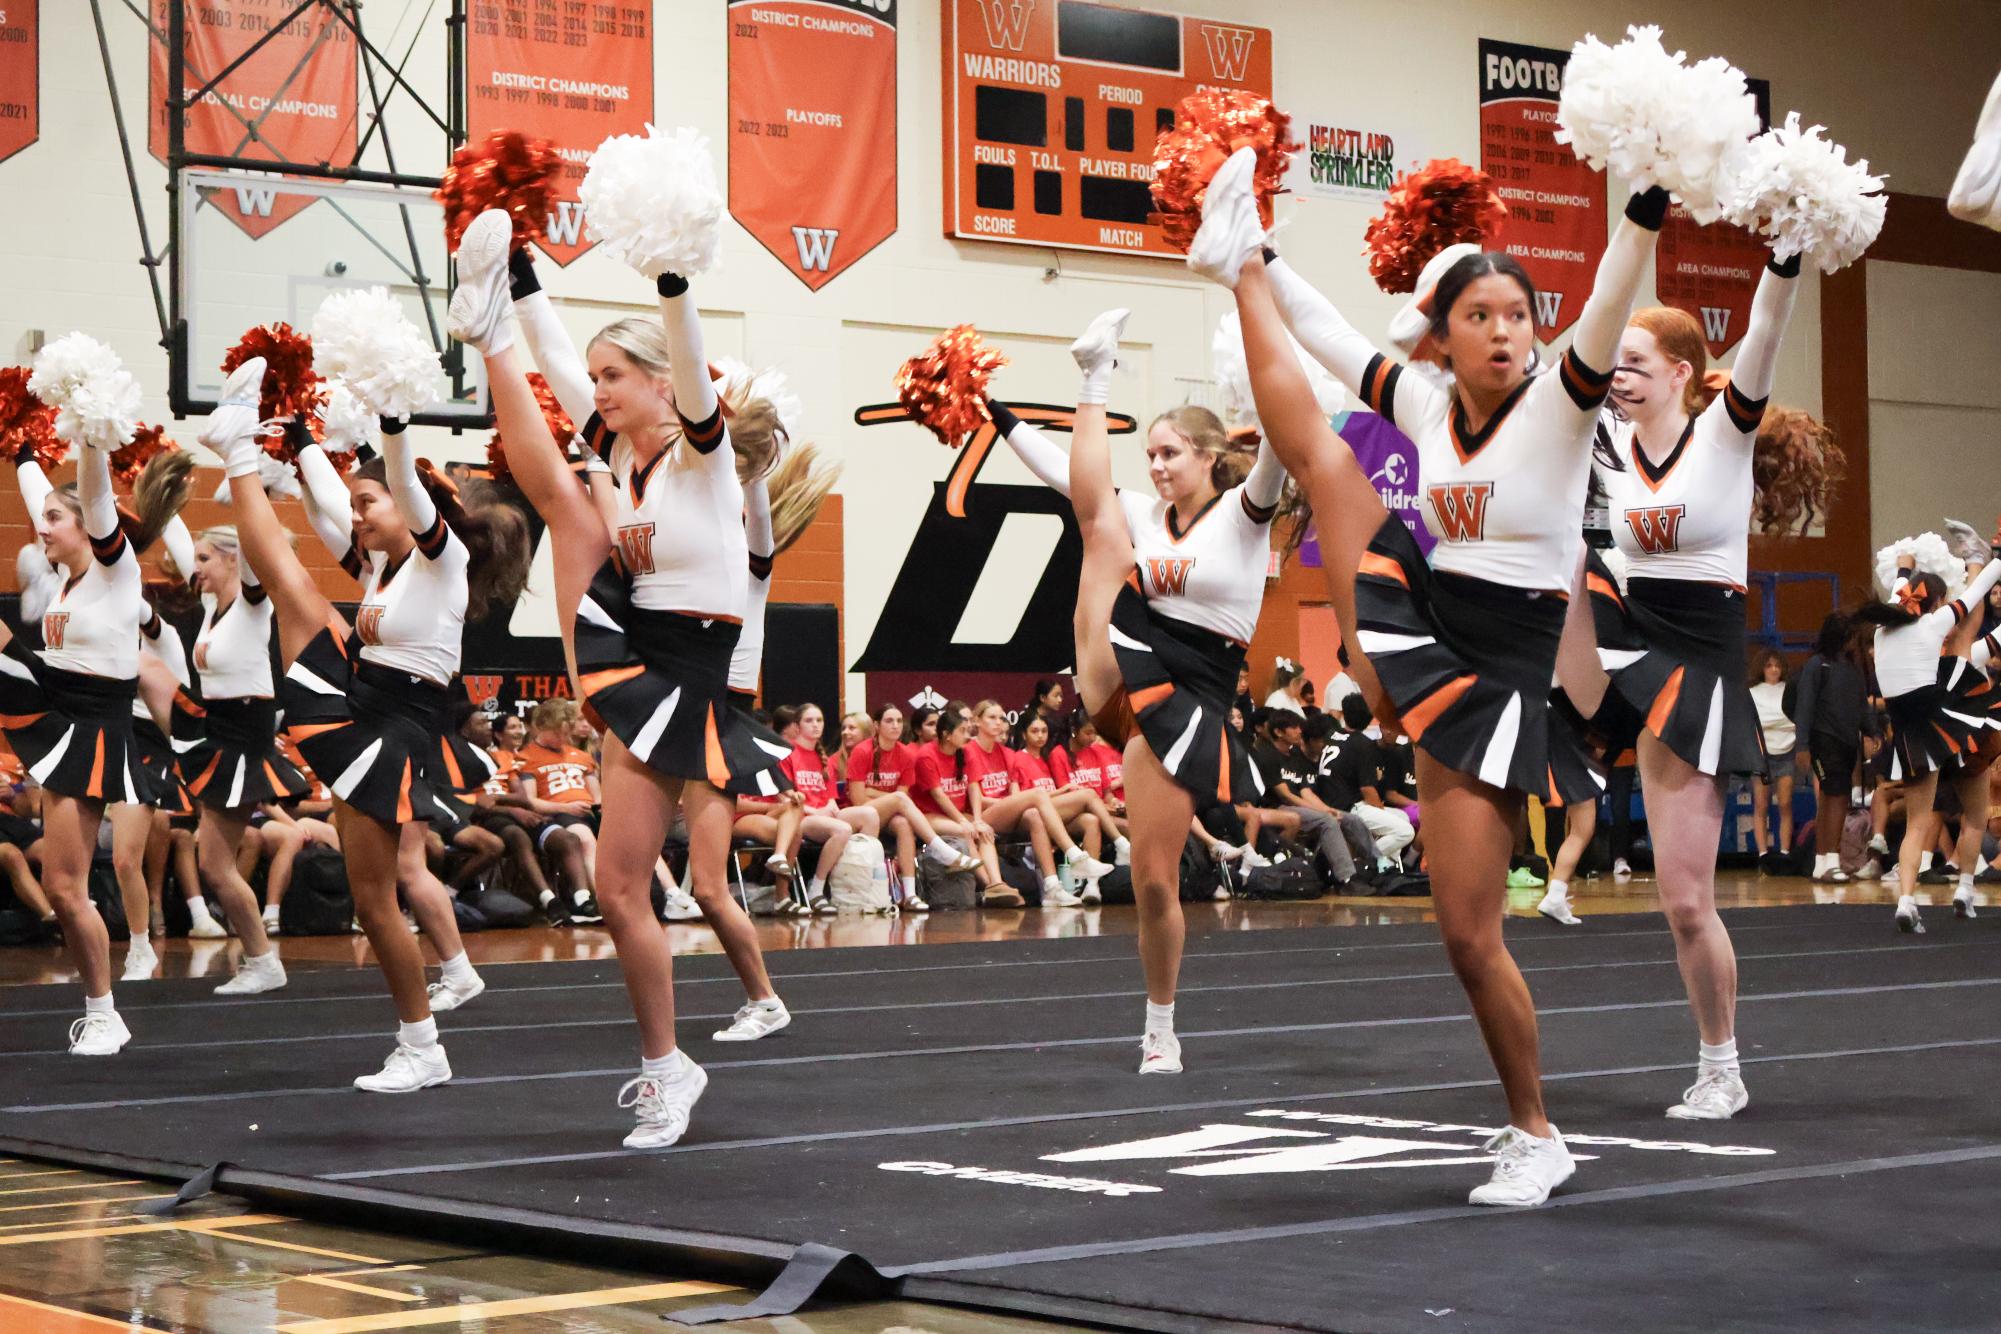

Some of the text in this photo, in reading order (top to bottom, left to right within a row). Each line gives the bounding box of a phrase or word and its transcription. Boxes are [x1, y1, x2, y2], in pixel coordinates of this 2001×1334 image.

[200, 8, 231, 27] 2003
[240, 13, 271, 32] 2014
[563, 16, 587, 31] 2014
[593, 20, 616, 35] 2015
[564, 1, 587, 16] 1997
[593, 5, 616, 20] 1998
[622, 8, 645, 23] 1999
[752, 8, 874, 38] DISTRICT CHAMPIONS
[534, 28, 557, 44] 2022
[563, 31, 587, 47] 2023
[735, 24, 758, 39] 2022
[1201, 24, 1255, 82] W
[492, 71, 629, 100] DISTRICT CHAMPIONS
[964, 53, 1061, 89] WARRIORS
[1486, 53, 1566, 92] FOOTB
[182, 87, 337, 119] EGIONAL CHAMPIONS
[506, 89, 530, 104] 1997
[1099, 84, 1143, 105] PERIOD
[0, 103, 28, 120] 2021
[786, 109, 843, 128] PLAYOFFS
[738, 120, 789, 138] 2022 2023
[1310, 124, 1394, 162] HEARTLAND
[974, 145, 1158, 181] FOULS T.O.L. PLAYER FOU
[1310, 152, 1393, 191] SPRINKLERS
[1498, 186, 1591, 208] DISTRICT CHAMPIONS
[1670, 207, 1691, 219] DIST
[547, 201, 586, 246] W
[974, 215, 1143, 248] SCORE MATCH
[791, 226, 839, 272] W
[1505, 244, 1585, 263] AREA CHAMPIONS
[1676, 262, 1751, 280] AREA CHAMPIONS
[1534, 291, 1563, 328] W
[1700, 307, 1732, 342] W
[1381, 487, 1421, 510] ildre
[1427, 481, 1495, 543] W
[1624, 503, 1686, 555] W
[617, 522, 656, 576] W
[1145, 556, 1197, 597] W
[43, 611, 70, 650] W
[358, 604, 387, 646] W
[462, 675, 577, 705] W THA
[1243, 1108, 1777, 1155] WESTOOD
[877, 1161, 1163, 1196] CHEER
